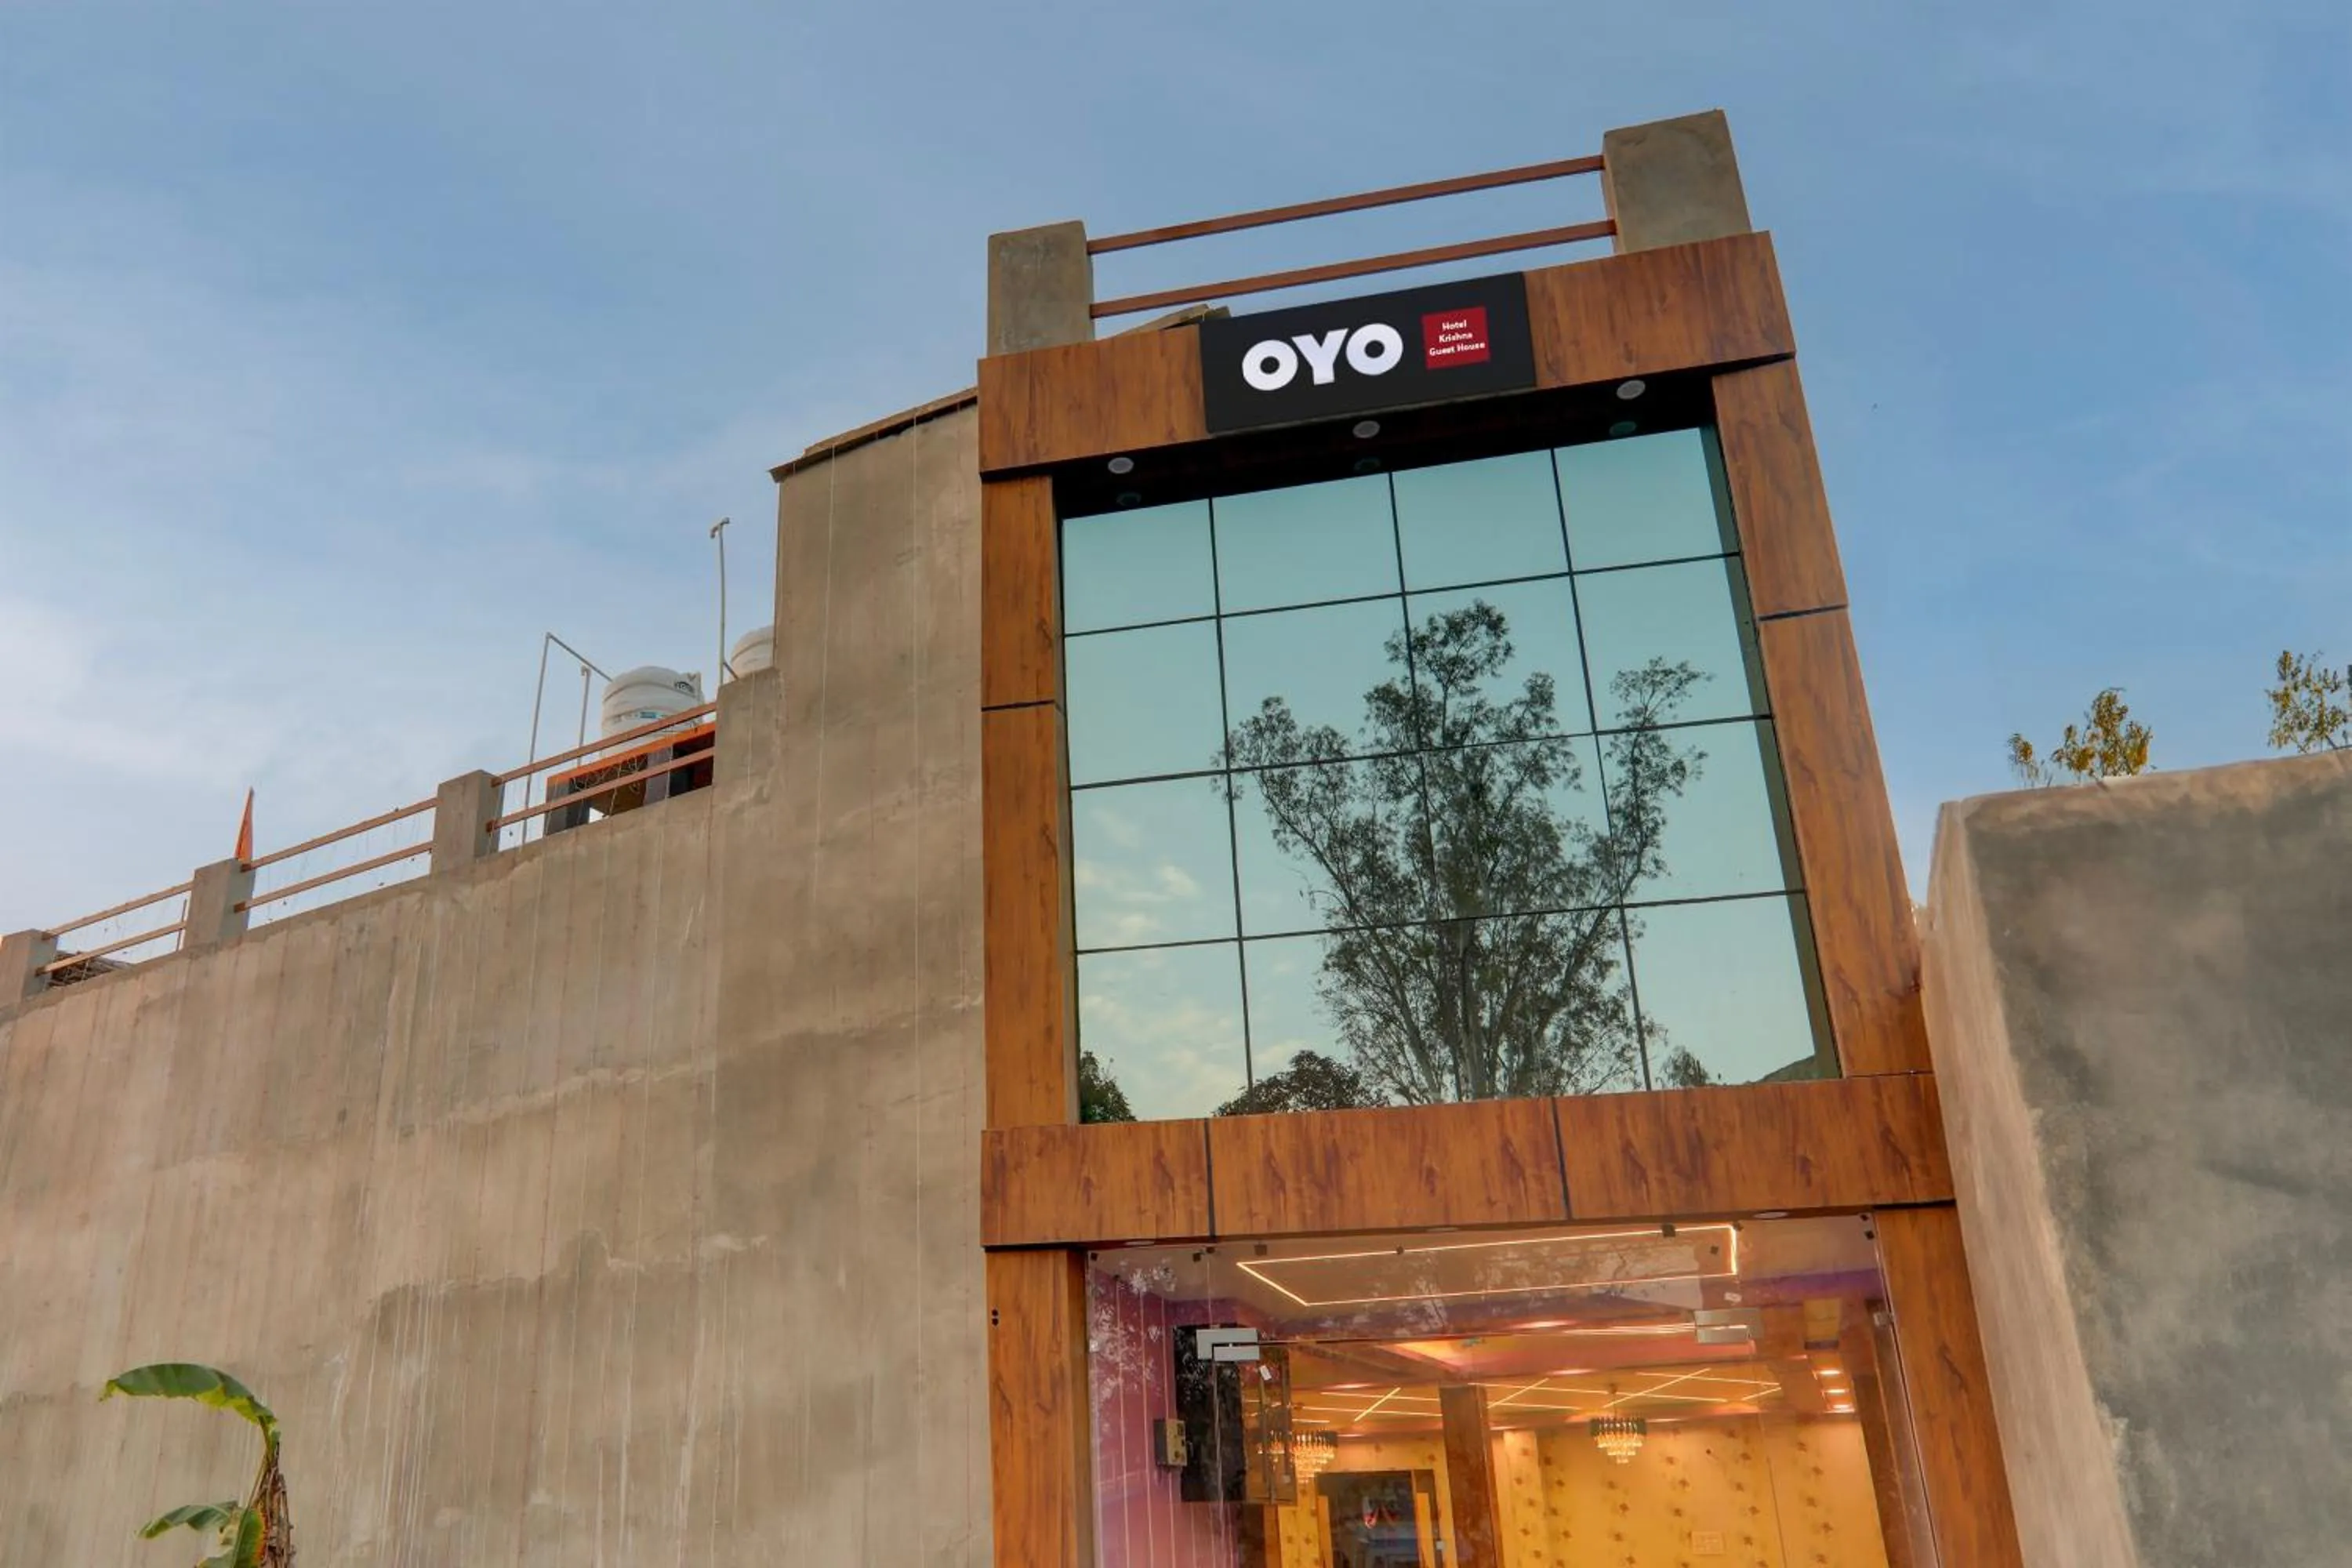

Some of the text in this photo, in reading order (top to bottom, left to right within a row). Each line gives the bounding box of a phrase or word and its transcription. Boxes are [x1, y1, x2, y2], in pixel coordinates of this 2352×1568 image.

[1442, 319, 1467, 330] Hotel
[1439, 332, 1473, 343] Krishna
[1429, 343, 1486, 356] Guest House
[1242, 323, 1403, 391] OYO
